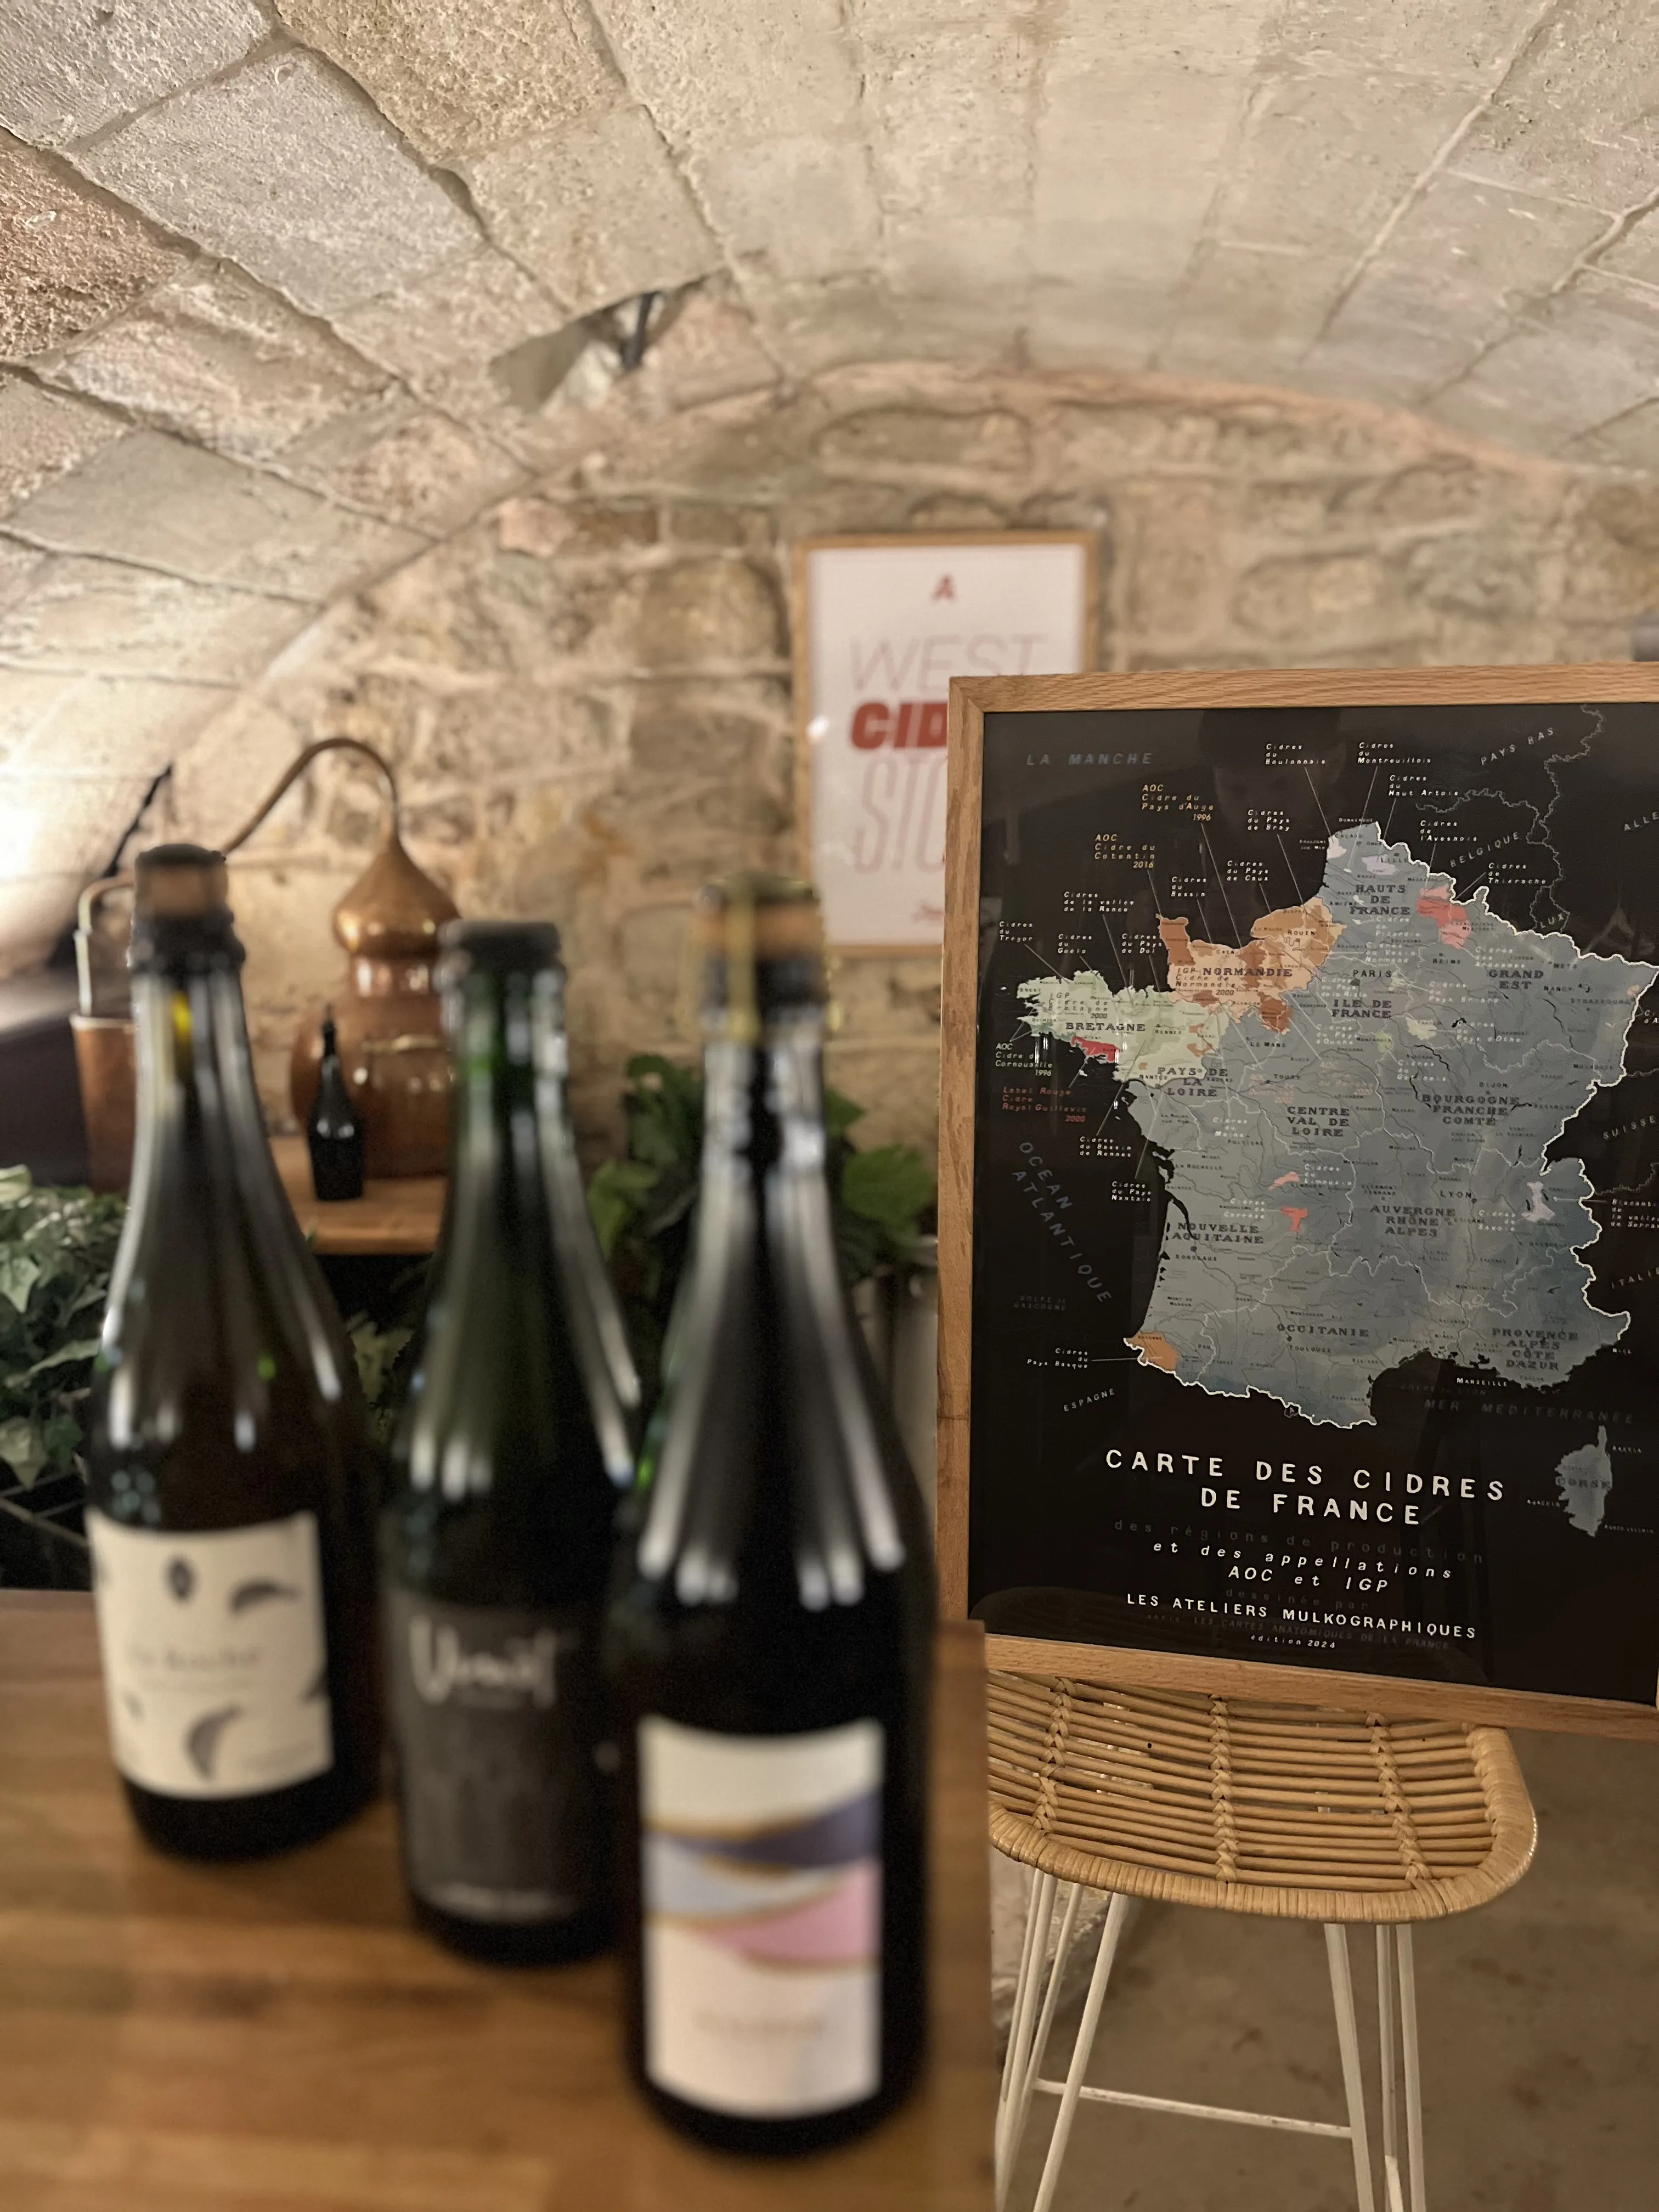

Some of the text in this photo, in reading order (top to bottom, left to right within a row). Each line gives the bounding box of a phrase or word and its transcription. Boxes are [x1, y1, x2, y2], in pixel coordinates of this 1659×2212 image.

[850, 633, 1050, 693] WEST
[850, 701, 949, 749] CID
[1481, 728, 1555, 765] PAYS BAS
[1026, 753, 1152, 765] LA MANCHE
[1142, 803, 1169, 811] Pays
[1450, 832, 1520, 867] BELGIQUE
[1356, 885, 1406, 894] HAUTS
[1370, 895, 1391, 904] DE
[1350, 906, 1411, 915] FRANCE
[1540, 913, 1564, 928] LUX
[1203, 968, 1293, 977] NORMANDIE
[1353, 969, 1392, 978] PARIS
[1489, 970, 1544, 979] GRAND
[1331, 1009, 1392, 1018] FRANCE
[1065, 1023, 1146, 1031] BRETAGNE
[1158, 1067, 1197, 1076] PAYS
[1167, 1087, 1218, 1097] LOIRE
[1421, 1094, 1520, 1105] BOURGOGNE
[1287, 1106, 1350, 1116] CENTRE
[1432, 1105, 1508, 1115] FRANCHE
[1287, 1116, 1317, 1125] VAL
[1291, 1127, 1344, 1137] LOIRE
[1603, 1115, 1656, 1141] SUISSE
[1019, 1142, 1073, 1209] OCEAN
[1370, 1205, 1455, 1216] AUVERGNE
[1178, 1222, 1259, 1233] NOUVELLE
[1385, 1227, 1437, 1237] ALPES
[1012, 1171, 1112, 1302] ATLANTIQUE
[1172, 1233, 1264, 1244] AQUITAINE
[1277, 1324, 1369, 1337] OCCITANIE
[1064, 1388, 1115, 1412] ESPAGNE
[1106, 1449, 1504, 1500] CARTE DES CIDRES
[1201, 1487, 1419, 1525] DE FRANCE
[1153, 1542, 1451, 1578] et des appellations
[1228, 1566, 1388, 1592] AOC et IGP
[1127, 1593, 1475, 1639] LES ATELIERS MULKOGRAPHIQUES
[1307, 1640, 1336, 1649] 2024
